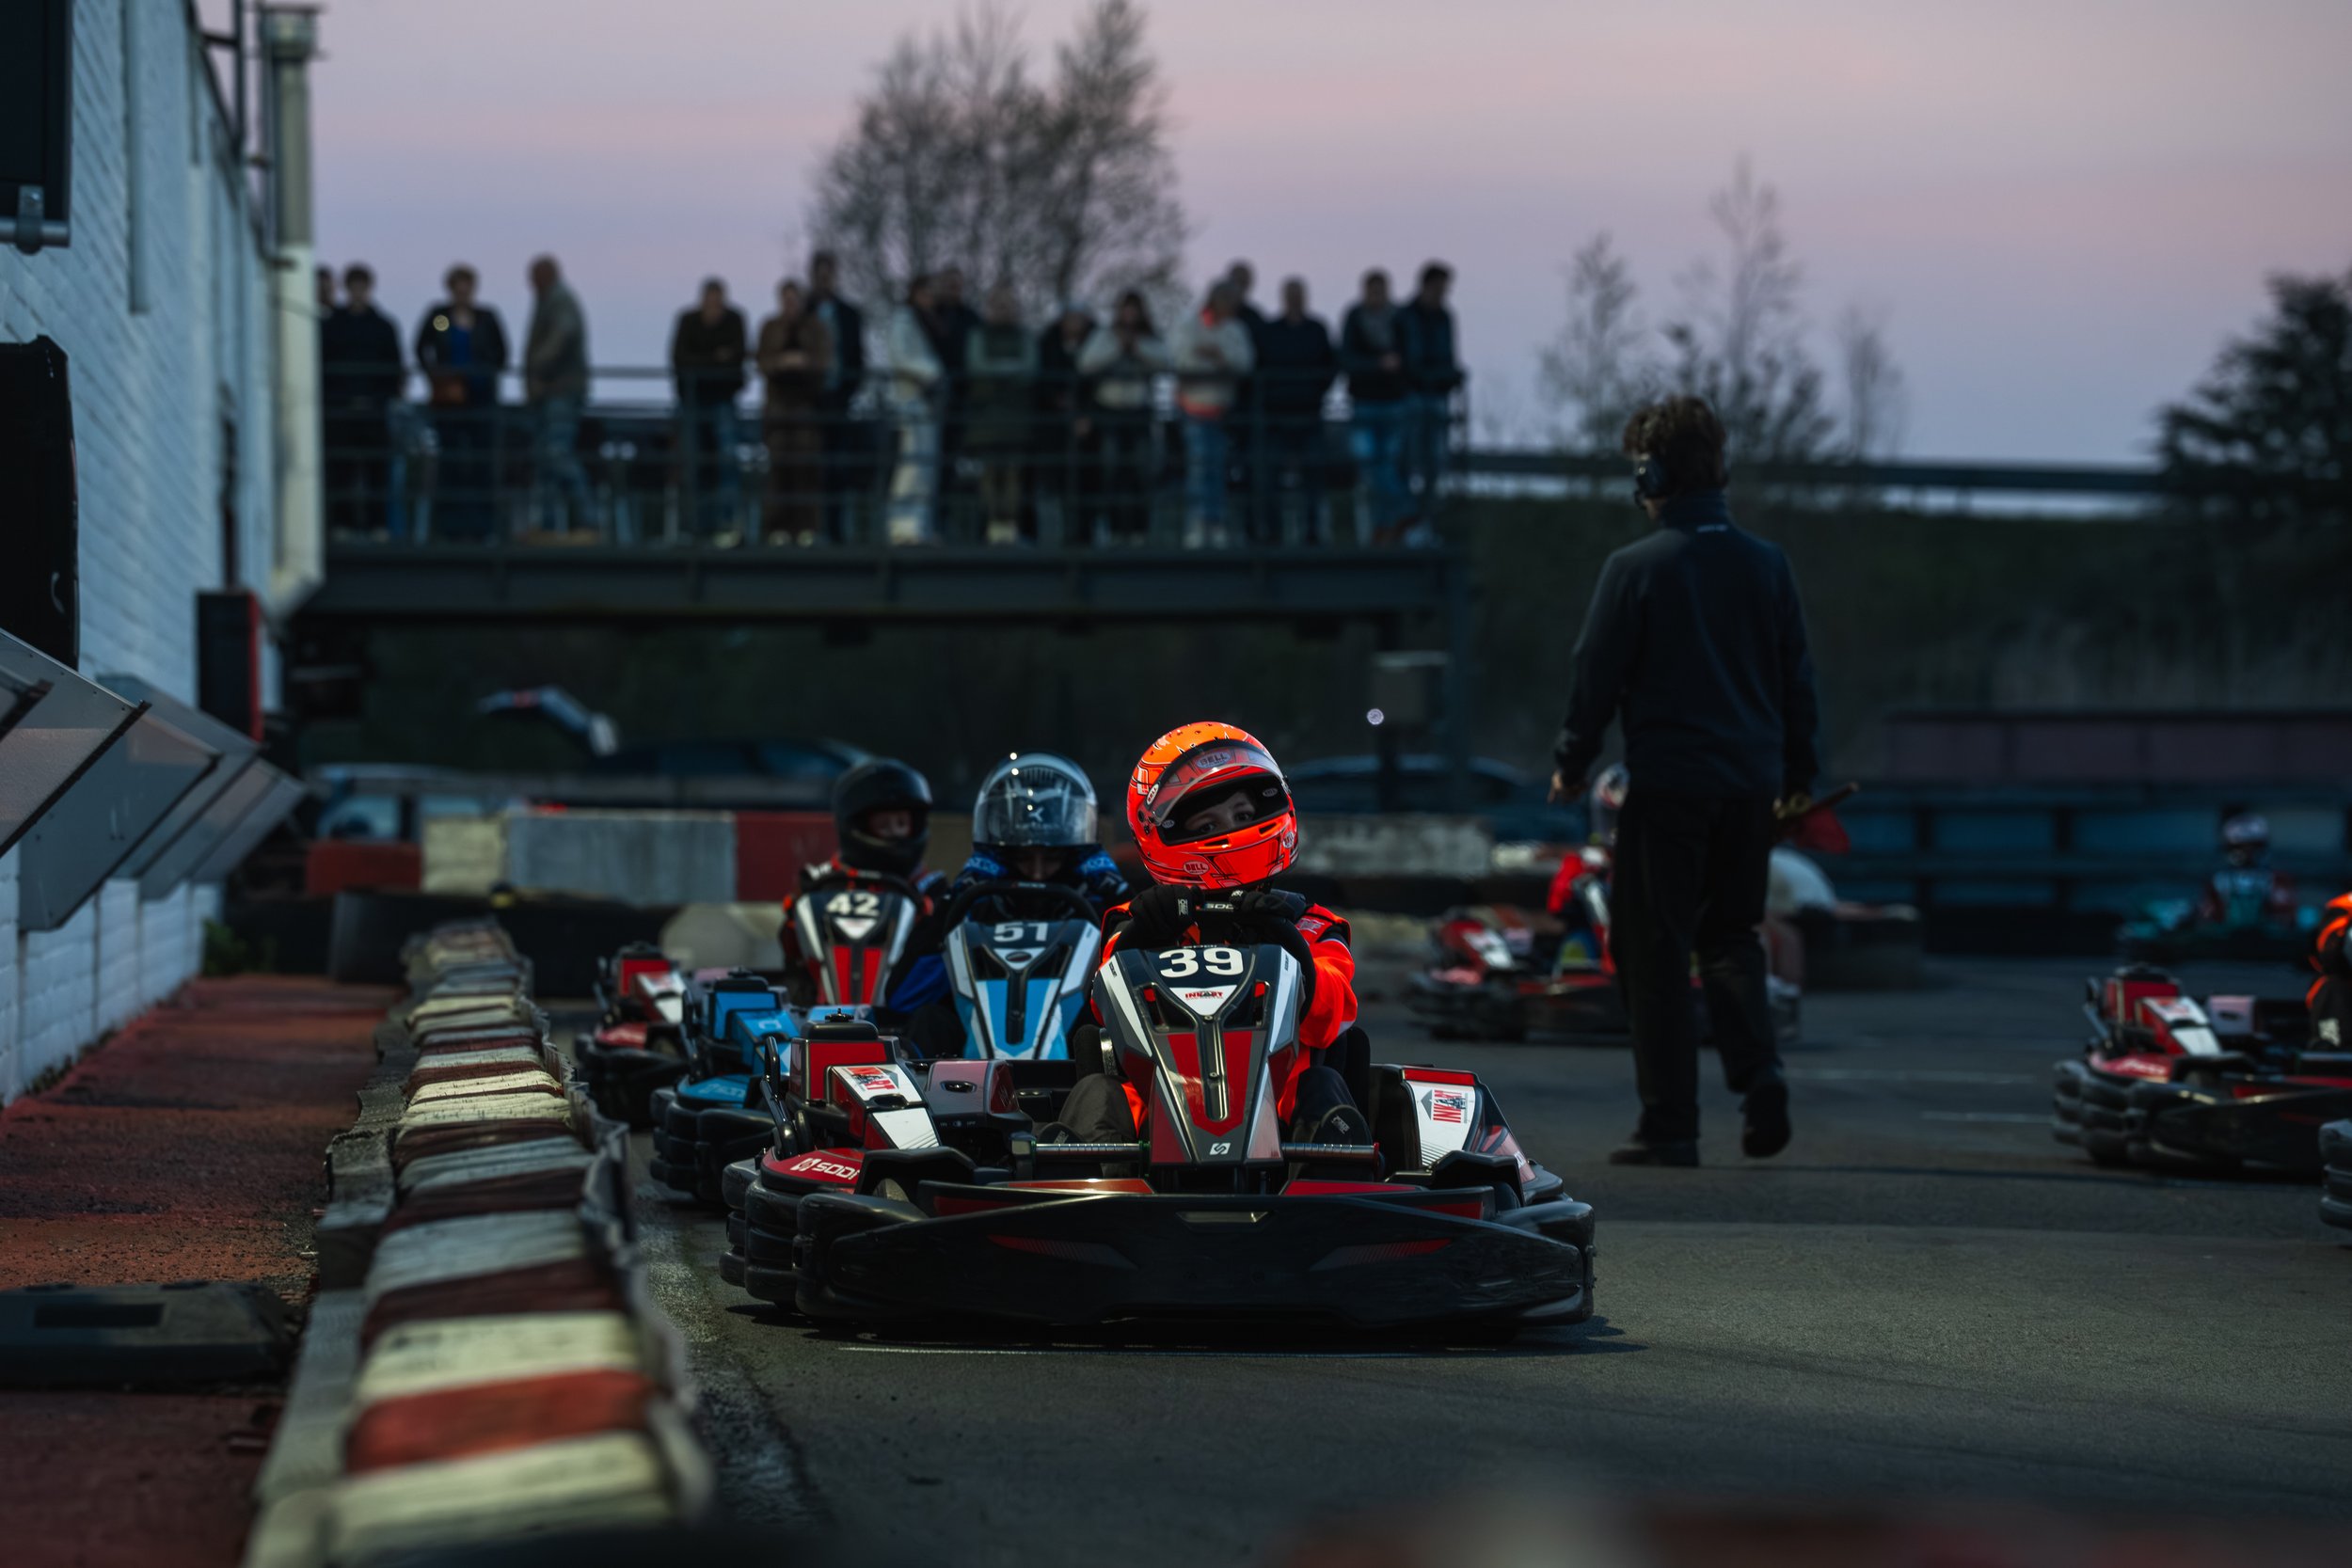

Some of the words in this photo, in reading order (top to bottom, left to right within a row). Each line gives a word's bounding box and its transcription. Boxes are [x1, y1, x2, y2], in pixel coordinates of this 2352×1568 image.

[826, 893, 880, 916] 42
[993, 921, 1049, 942] 51
[1158, 947, 1244, 978] 39
